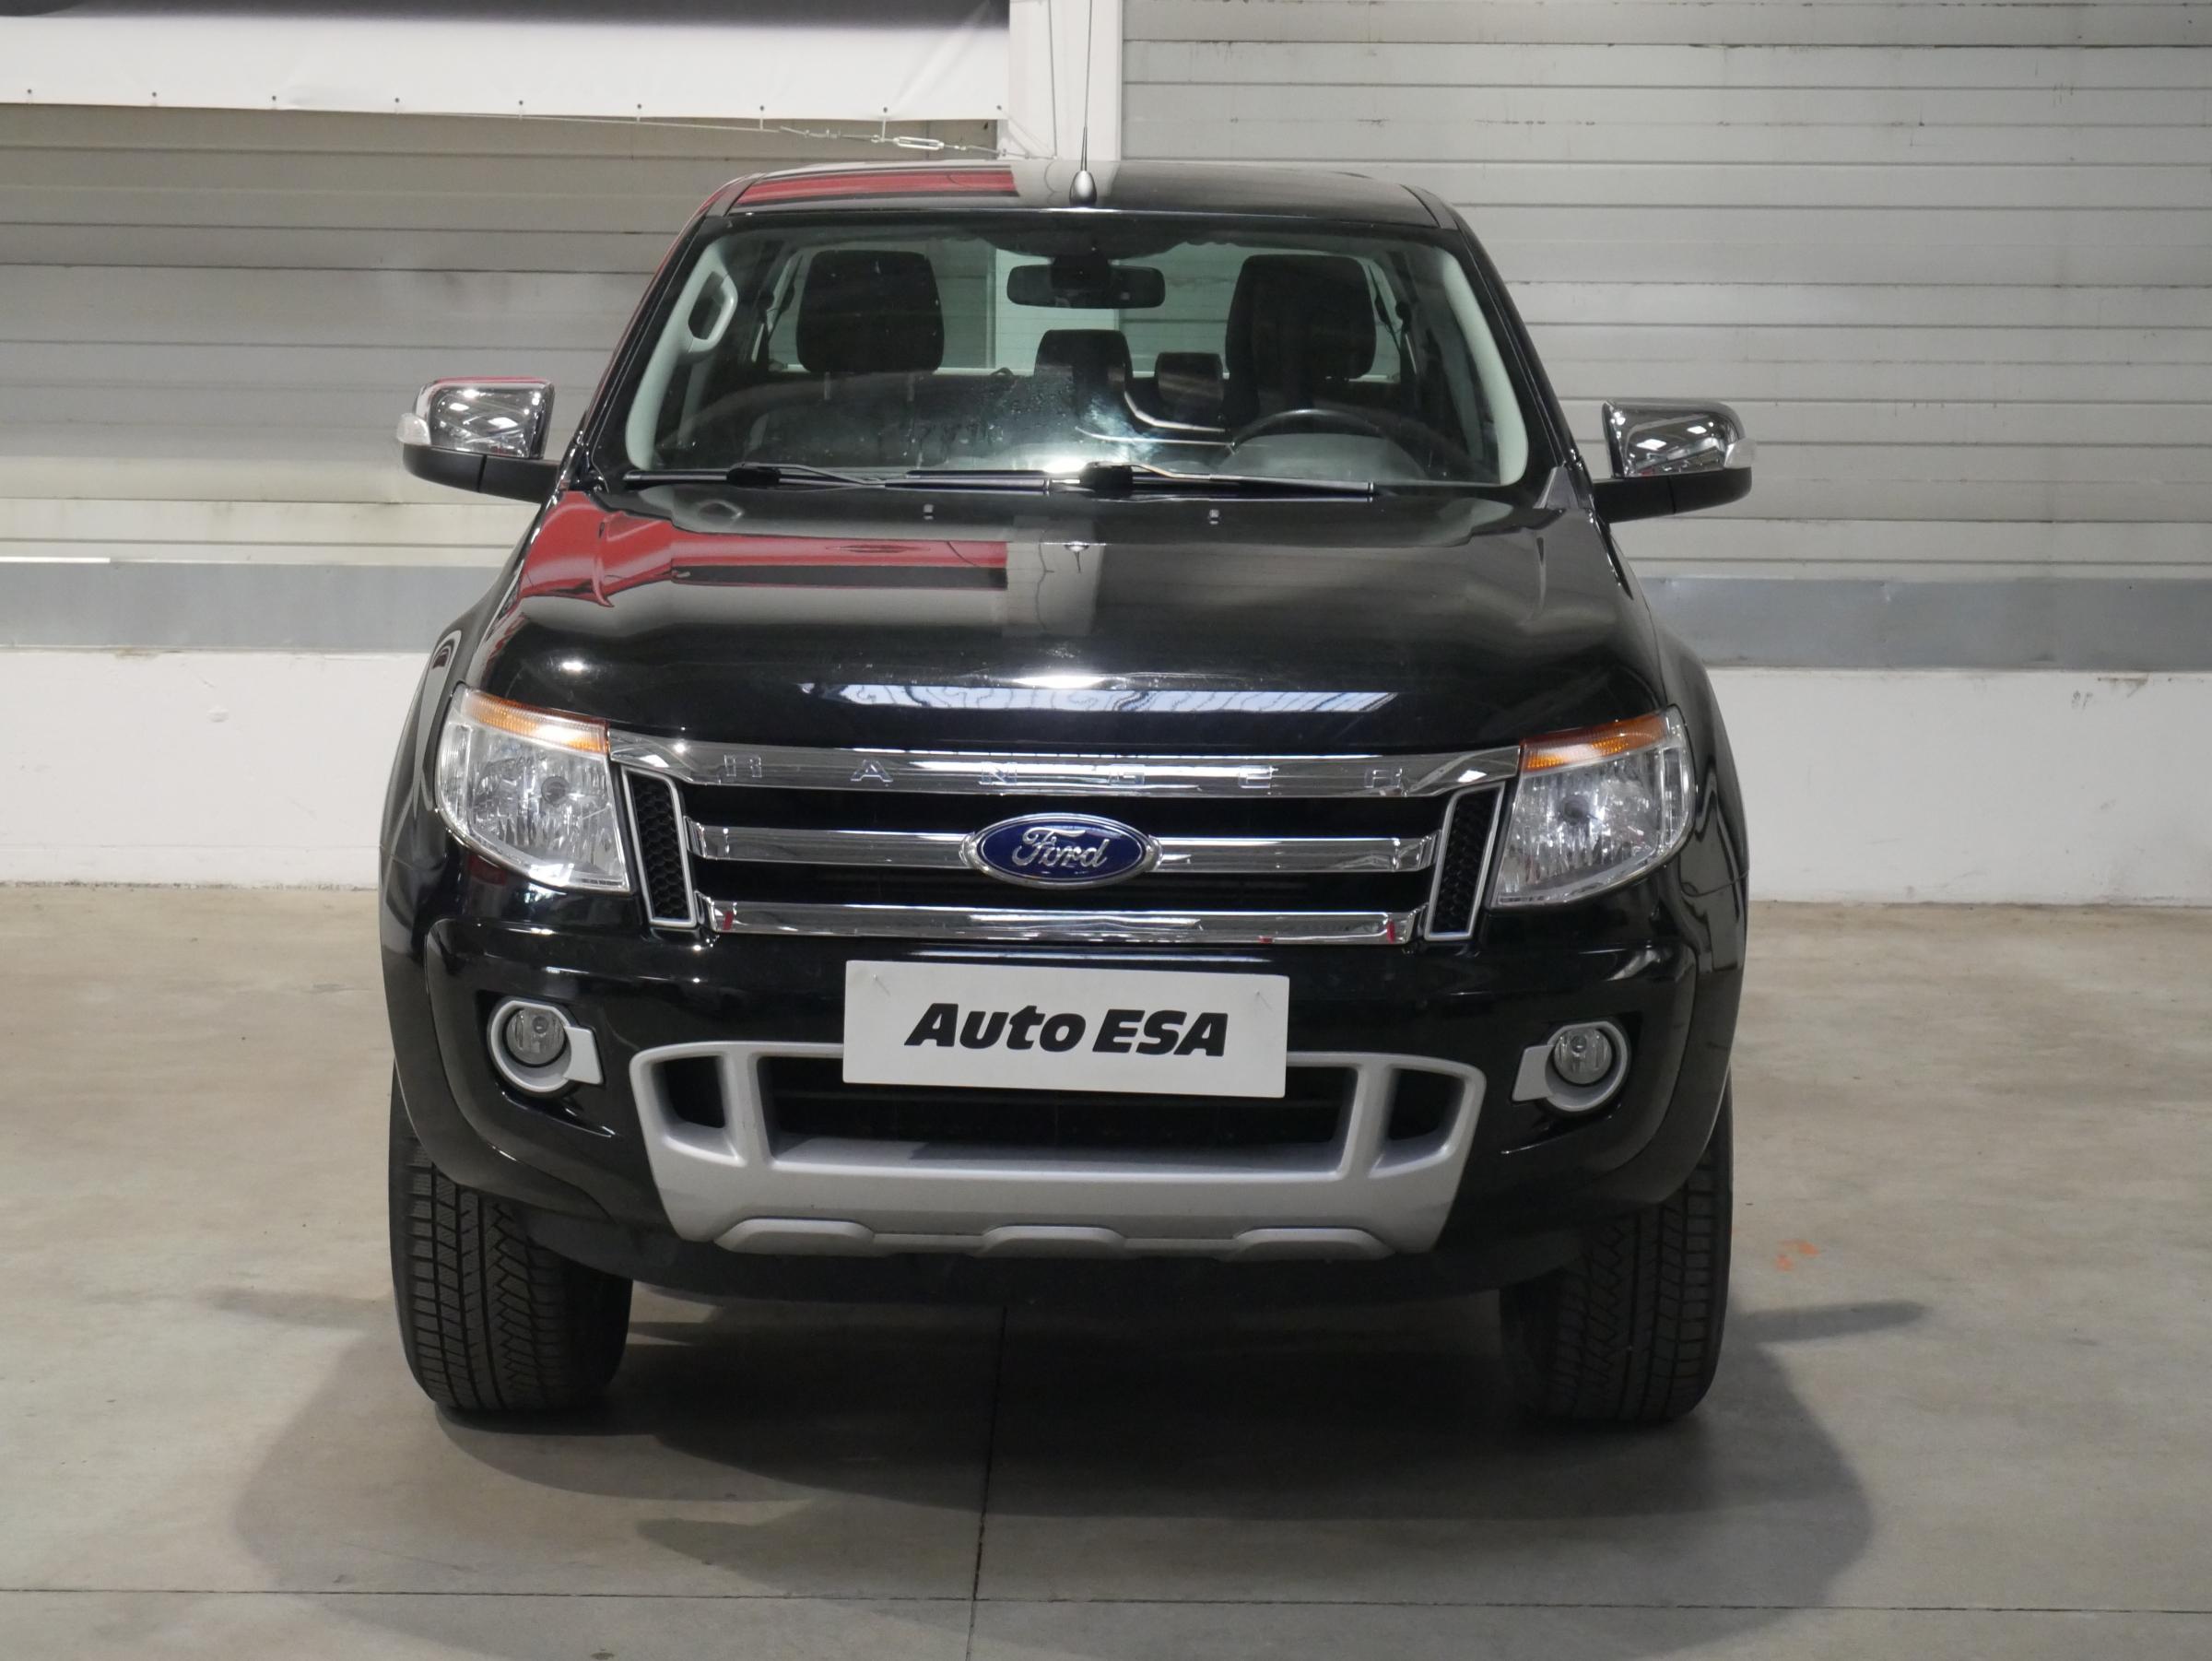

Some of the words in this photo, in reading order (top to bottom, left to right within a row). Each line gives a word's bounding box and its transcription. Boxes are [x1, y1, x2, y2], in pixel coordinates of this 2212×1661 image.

[1011, 826, 1111, 868] Ford
[903, 1002, 1087, 1053] Auto
[1092, 1008, 1229, 1057] ESA
